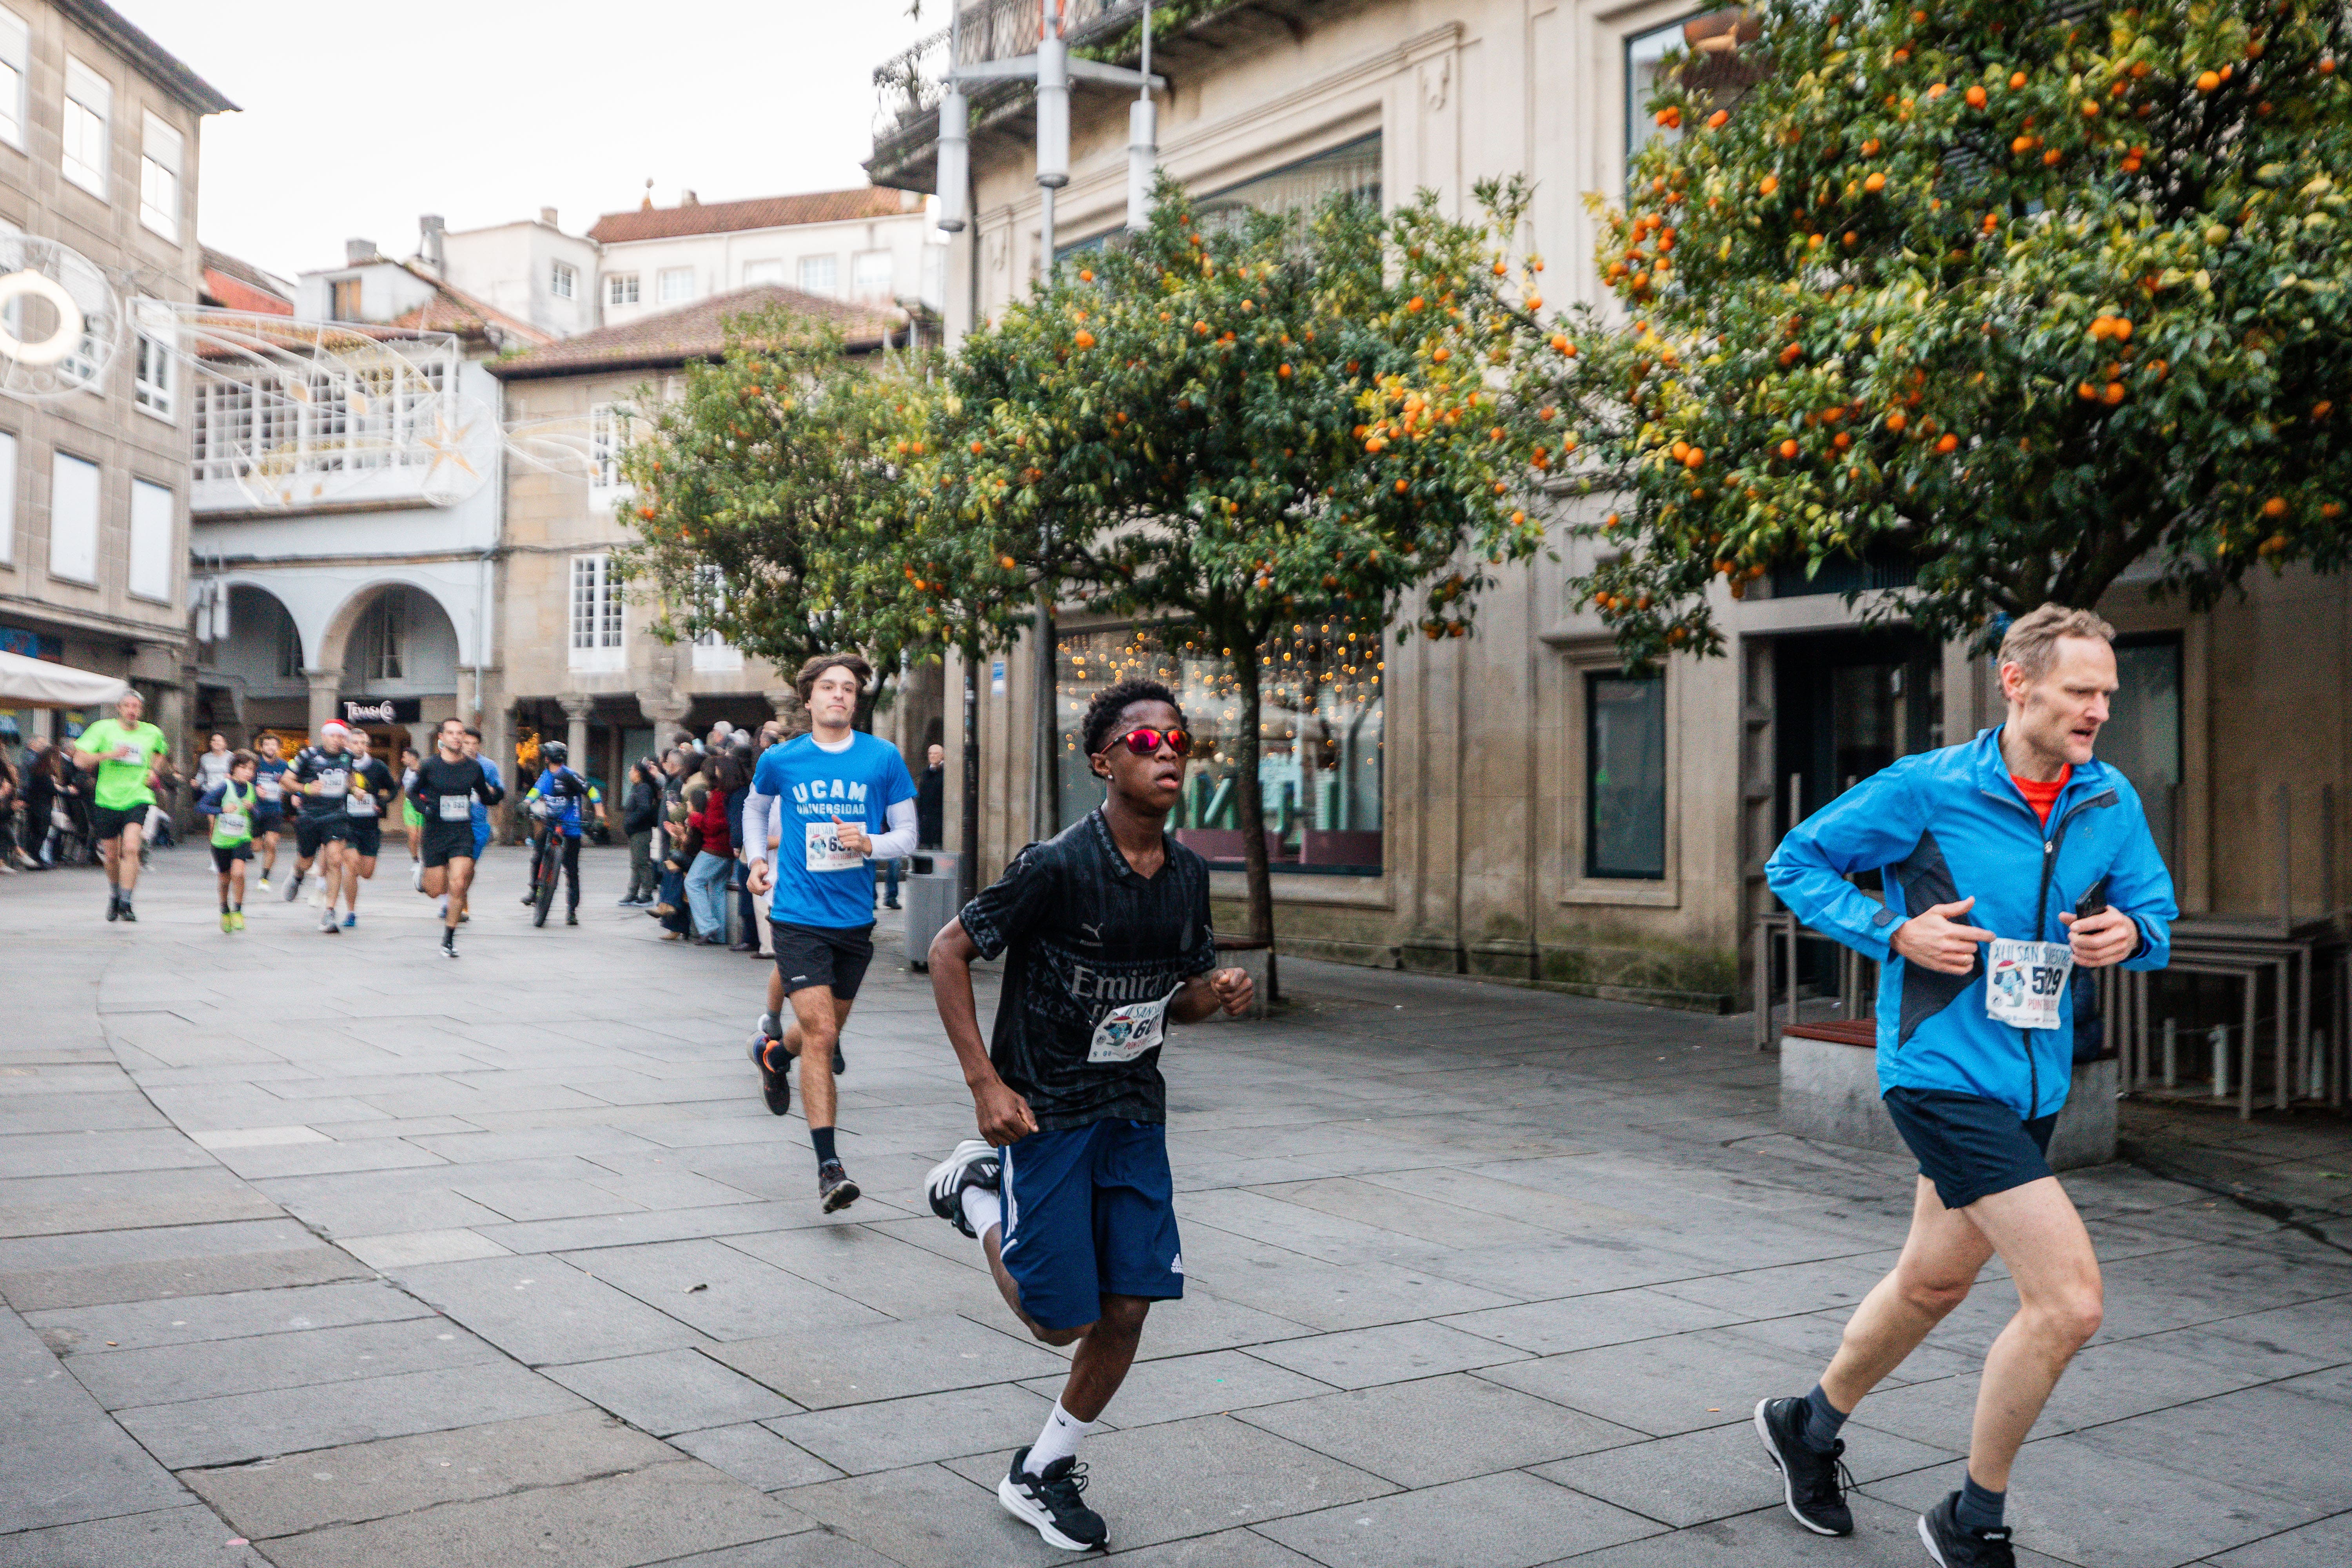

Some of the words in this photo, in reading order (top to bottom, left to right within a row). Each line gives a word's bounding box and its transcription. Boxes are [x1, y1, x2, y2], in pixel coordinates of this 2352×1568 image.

[792, 779, 867, 802] UCAM
[797, 803, 865, 815] UNIVERSIDAD
[821, 825, 833, 835] SAN
[2018, 945, 2039, 962] SAN
[2032, 966, 2063, 996] 529
[1132, 1006, 1154, 1018] SAN
